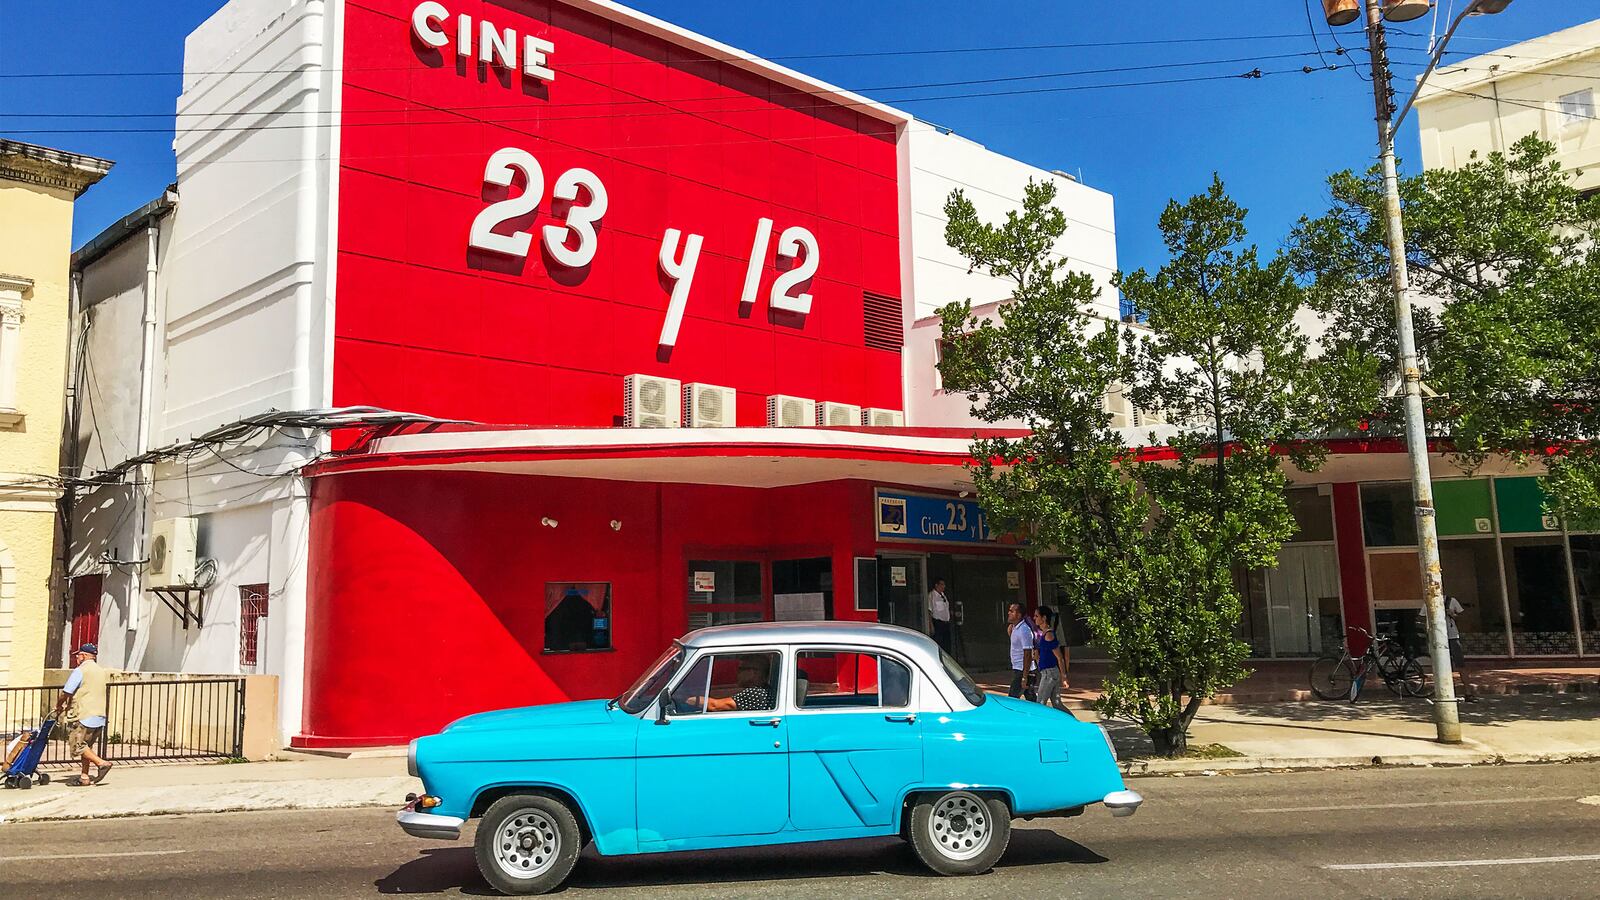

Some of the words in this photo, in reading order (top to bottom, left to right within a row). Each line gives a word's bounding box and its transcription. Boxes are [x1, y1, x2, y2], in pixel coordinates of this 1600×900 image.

[411, 0, 555, 81] CINE
[468, 147, 609, 268] 23
[740, 217, 820, 315] 12
[921, 515, 945, 536] Cine
[946, 502, 967, 532] 23
[971, 525, 976, 538] y
